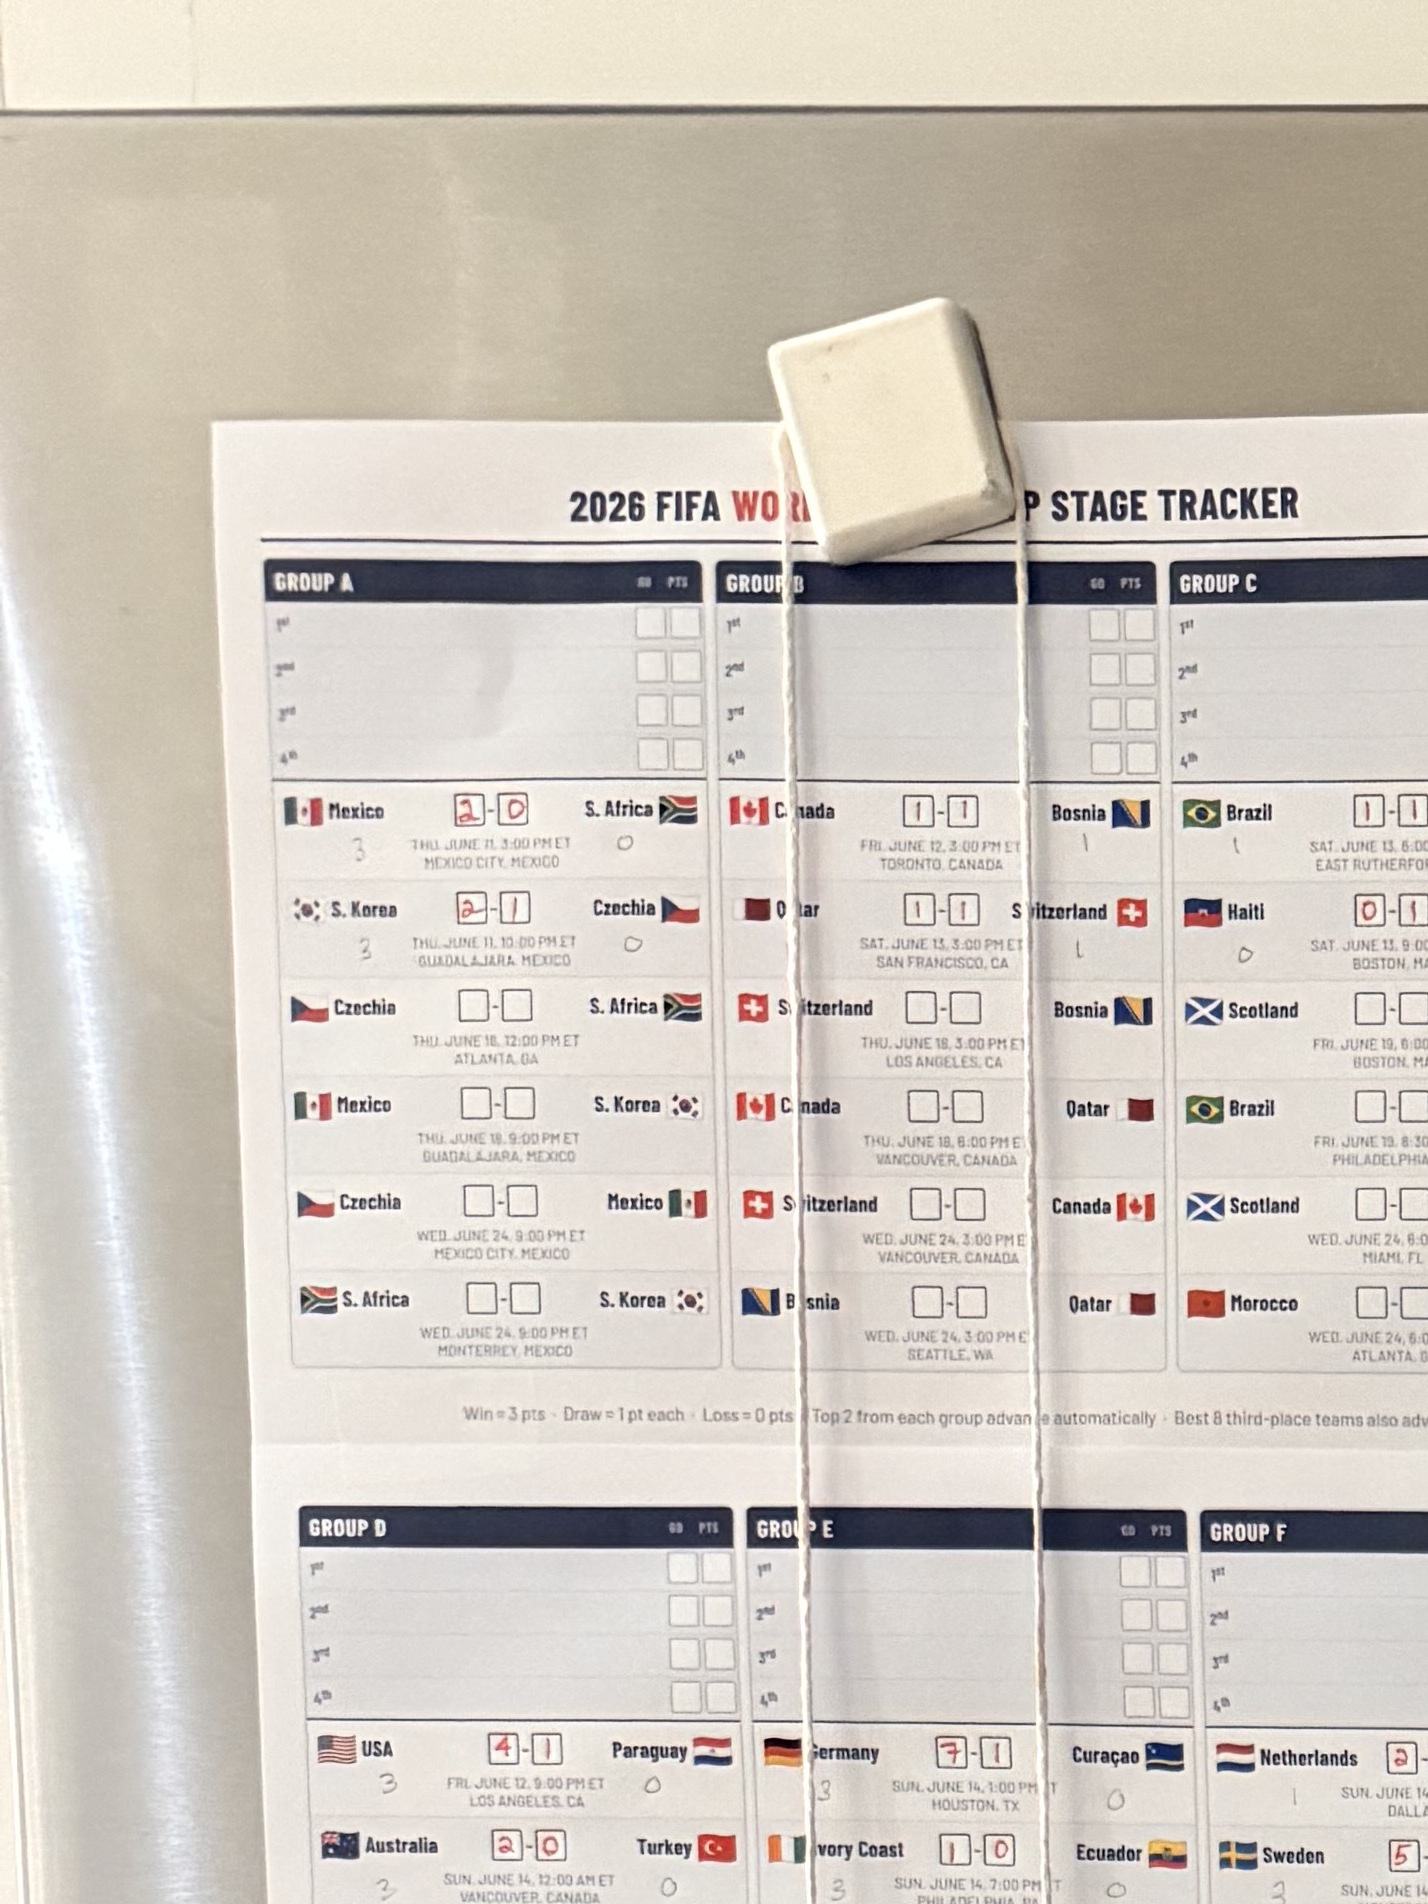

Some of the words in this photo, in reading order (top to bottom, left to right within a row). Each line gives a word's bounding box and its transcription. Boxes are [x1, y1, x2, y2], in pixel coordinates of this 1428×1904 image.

[570, 491, 645, 522] 2026
[656, 491, 720, 521] FIFA
[1051, 490, 1147, 521] STAGE
[1158, 487, 1298, 521] TRACKER
[275, 573, 334, 591] GROUP
[341, 573, 353, 591] A
[1180, 574, 1239, 593] GROUP
[1246, 573, 1256, 592] C
[329, 802, 384, 819] Mexico
[585, 800, 600, 817] S.
[605, 800, 653, 817] Africa
[1227, 803, 1272, 821] Brazil
[1316, 858, 1348, 871] EAST
[1053, 1198, 1111, 1214] Canada
[1175, 1411, 1209, 1425] Best
[1213, 1411, 1222, 1425] 8
[1226, 1411, 1311, 1429] third-place
[1316, 1414, 1363, 1427] teams
[1367, 1414, 1398, 1427] also
[309, 1519, 368, 1536] GROUP
[375, 1519, 386, 1536] D
[1211, 1523, 1269, 1541] GROUP
[1277, 1523, 1287, 1541] F
[362, 1741, 393, 1757] USA
[494, 1735, 512, 1758] 4
[1073, 1746, 1139, 1767] Curaçao
[1261, 1749, 1358, 1766] Netherlands
[366, 1837, 438, 1853] Australia
[1263, 1847, 1324, 1864] Sweden
[1392, 1844, 1412, 1867] 5
